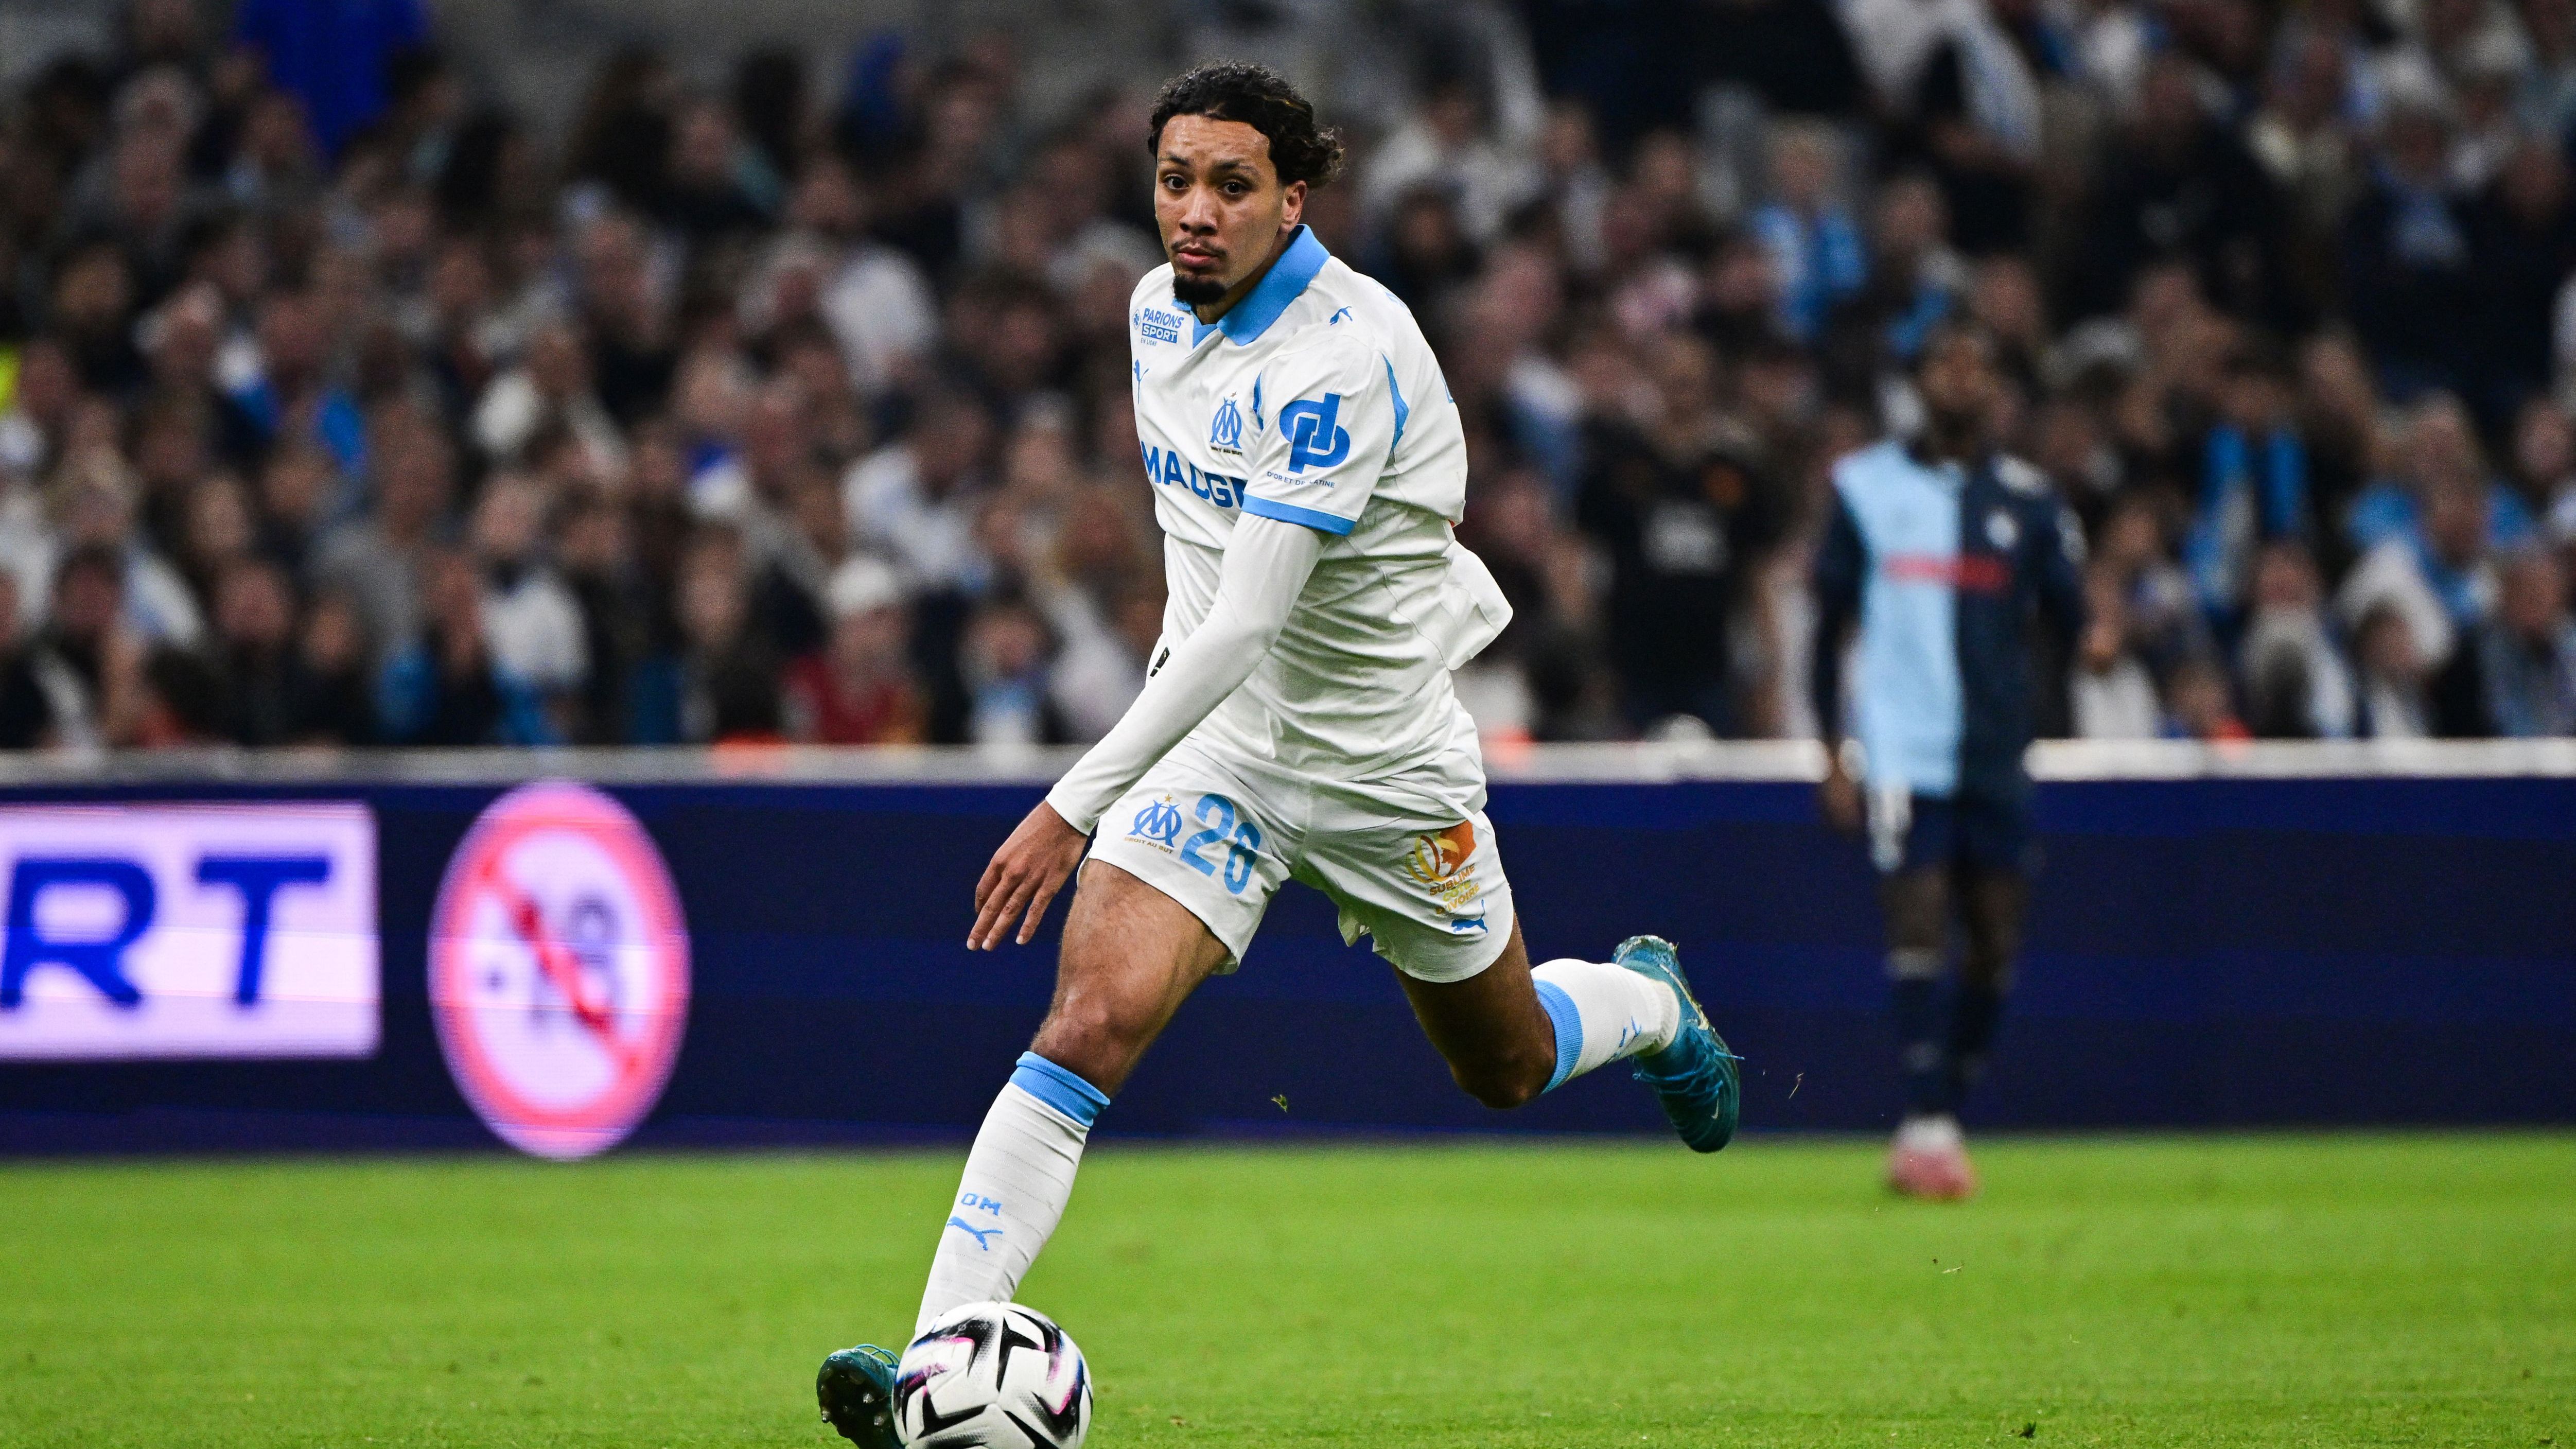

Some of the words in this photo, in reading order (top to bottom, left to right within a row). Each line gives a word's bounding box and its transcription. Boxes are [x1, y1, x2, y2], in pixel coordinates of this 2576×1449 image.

[1143, 308, 1185, 329] PARIONS
[1143, 324, 1177, 342] SPORT
[1267, 471, 1283, 481] D'OR
[1159, 845, 1174, 854] BUT
[1179, 793, 1260, 895] 26
[1429, 865, 1475, 896] SUBLIME
[961, 1193, 1002, 1216] OM
